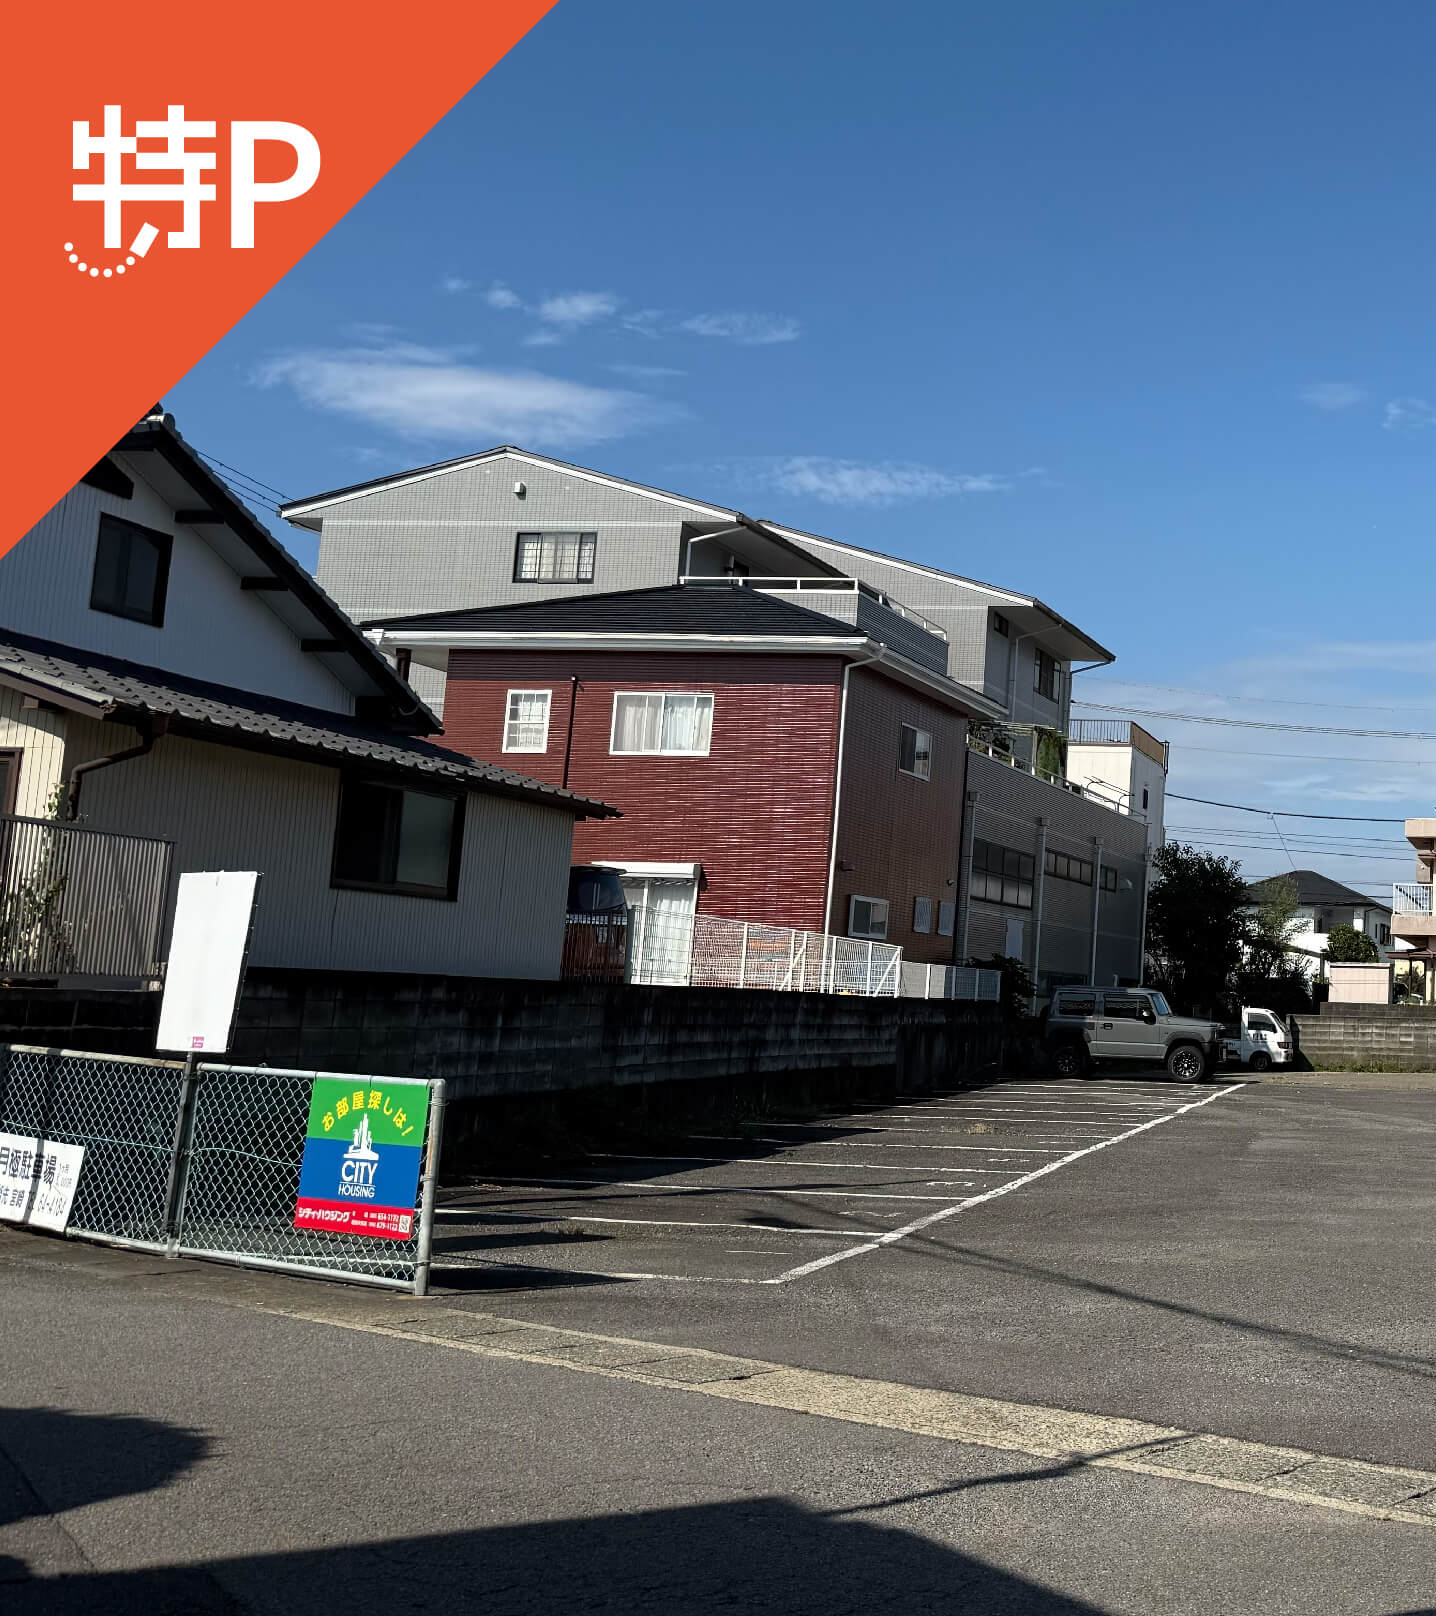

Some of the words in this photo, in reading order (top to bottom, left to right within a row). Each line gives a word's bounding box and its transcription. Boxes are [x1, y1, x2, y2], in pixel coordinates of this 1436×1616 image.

[0, 1146, 57, 1190] 月極駐車場
[341, 1160, 378, 1185] CITY
[338, 1184, 375, 1199] HOUSING
